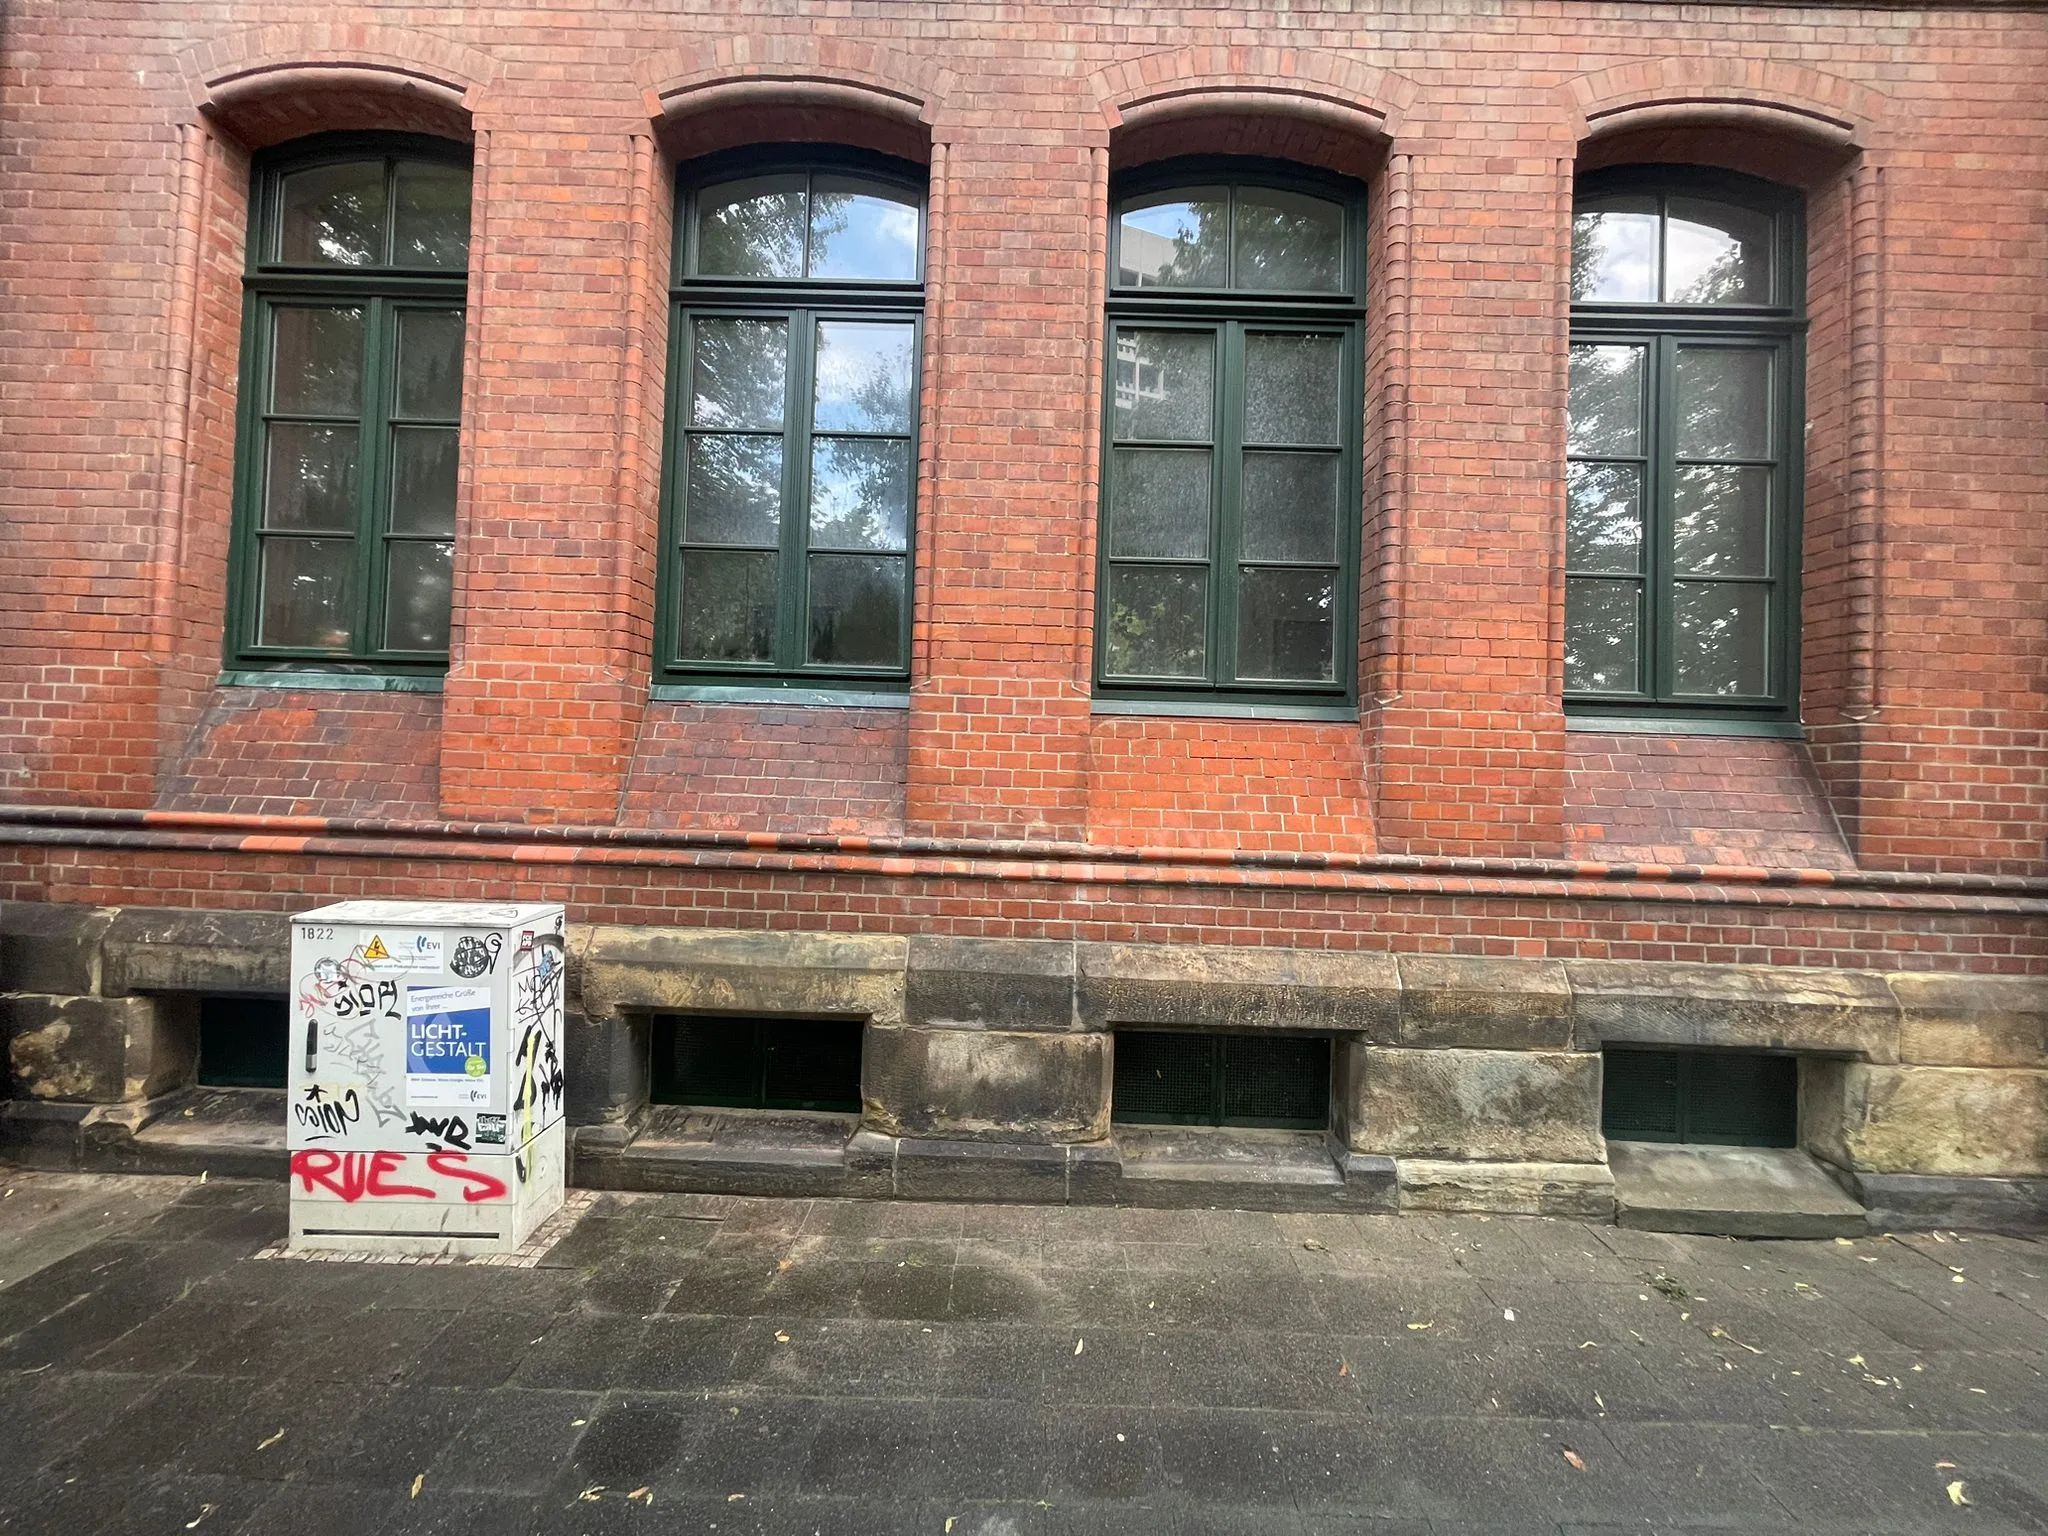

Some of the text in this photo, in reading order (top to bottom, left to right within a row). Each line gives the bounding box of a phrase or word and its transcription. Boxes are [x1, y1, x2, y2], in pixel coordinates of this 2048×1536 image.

[301, 927, 334, 941] 1822
[426, 941, 441, 950] EVI
[411, 1023, 468, 1040] LICHT-
[411, 1041, 487, 1057] GESTALT
